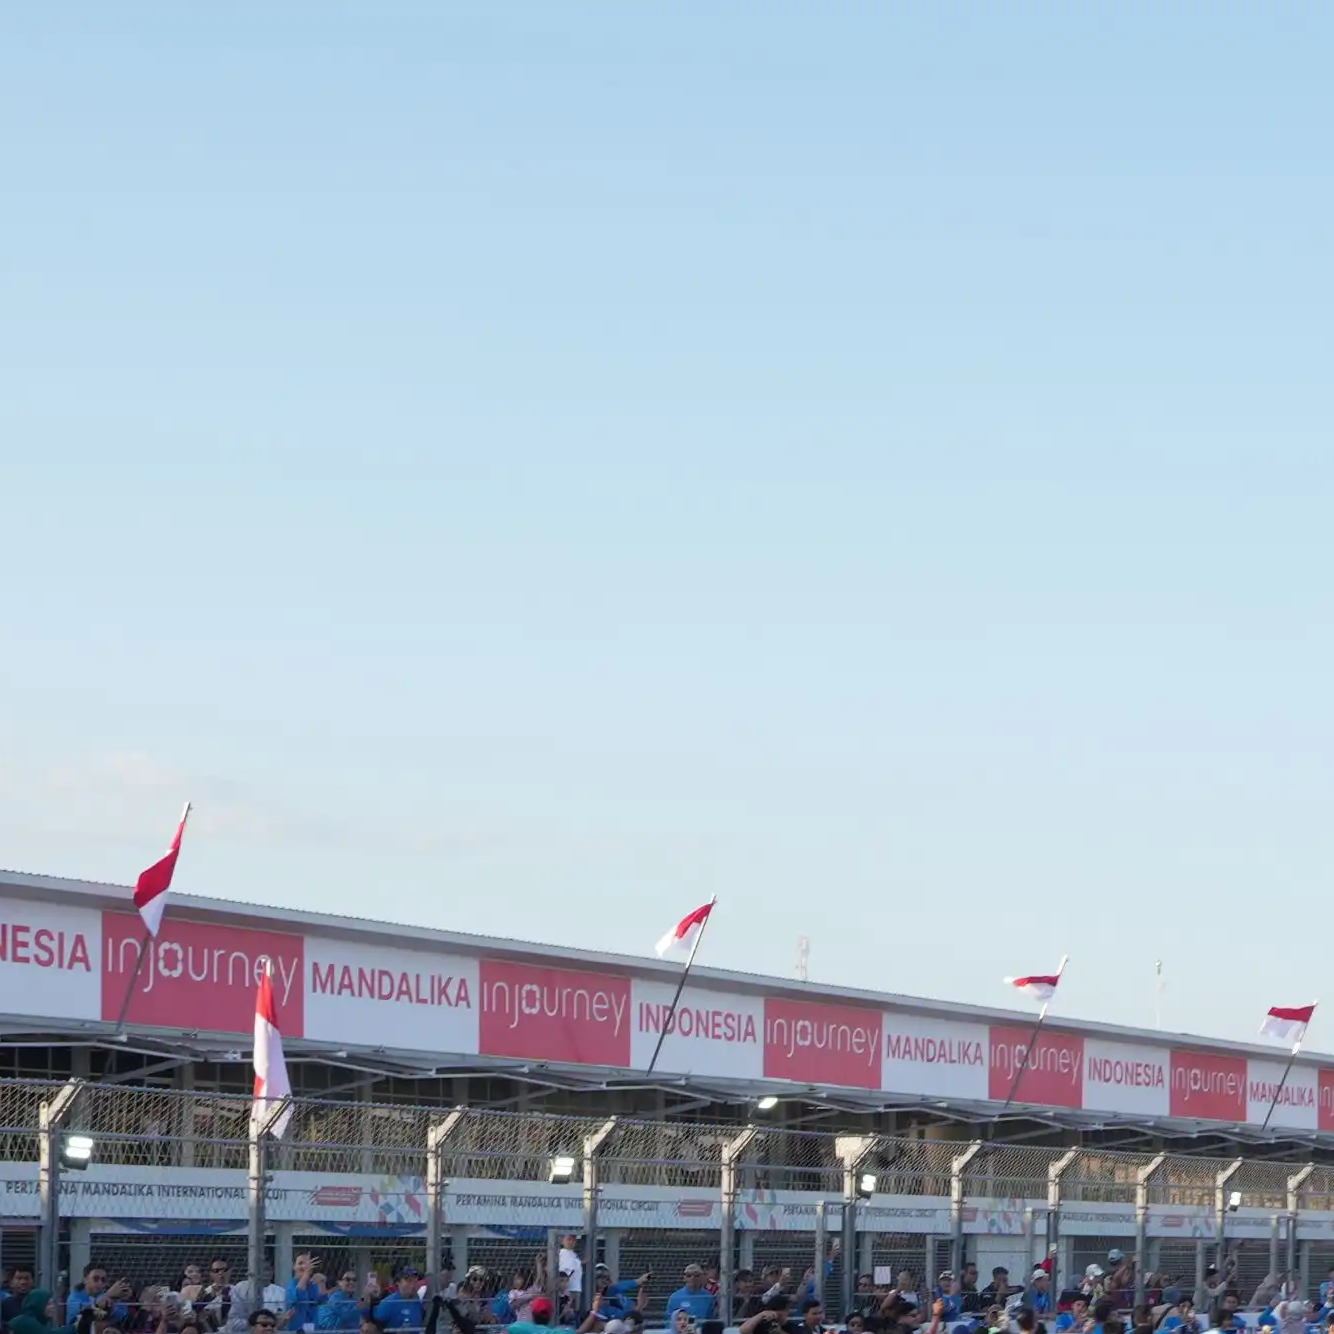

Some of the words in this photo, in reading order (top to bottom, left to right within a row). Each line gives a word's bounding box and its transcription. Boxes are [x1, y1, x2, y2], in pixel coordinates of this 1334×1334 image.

[108, 937, 299, 1007] injourney
[312, 962, 471, 1009] MANDALIKA
[483, 980, 626, 1037] injourney
[639, 1002, 757, 1043] INDONESIA
[767, 1018, 879, 1067] injourney
[887, 1034, 983, 1066] MANDALIKA
[991, 1043, 1081, 1085] injourney
[1088, 1057, 1165, 1088] INDONESIA
[1171, 1066, 1246, 1104] injourney
[1249, 1081, 1315, 1107] MANDALIKA
[6, 1180, 78, 1196] PERTANA
[81, 1181, 153, 1198] MANDALIKA
[157, 1183, 247, 1200] INTERNATIONAL
[564, 1198, 628, 1211] INTETIONAL
